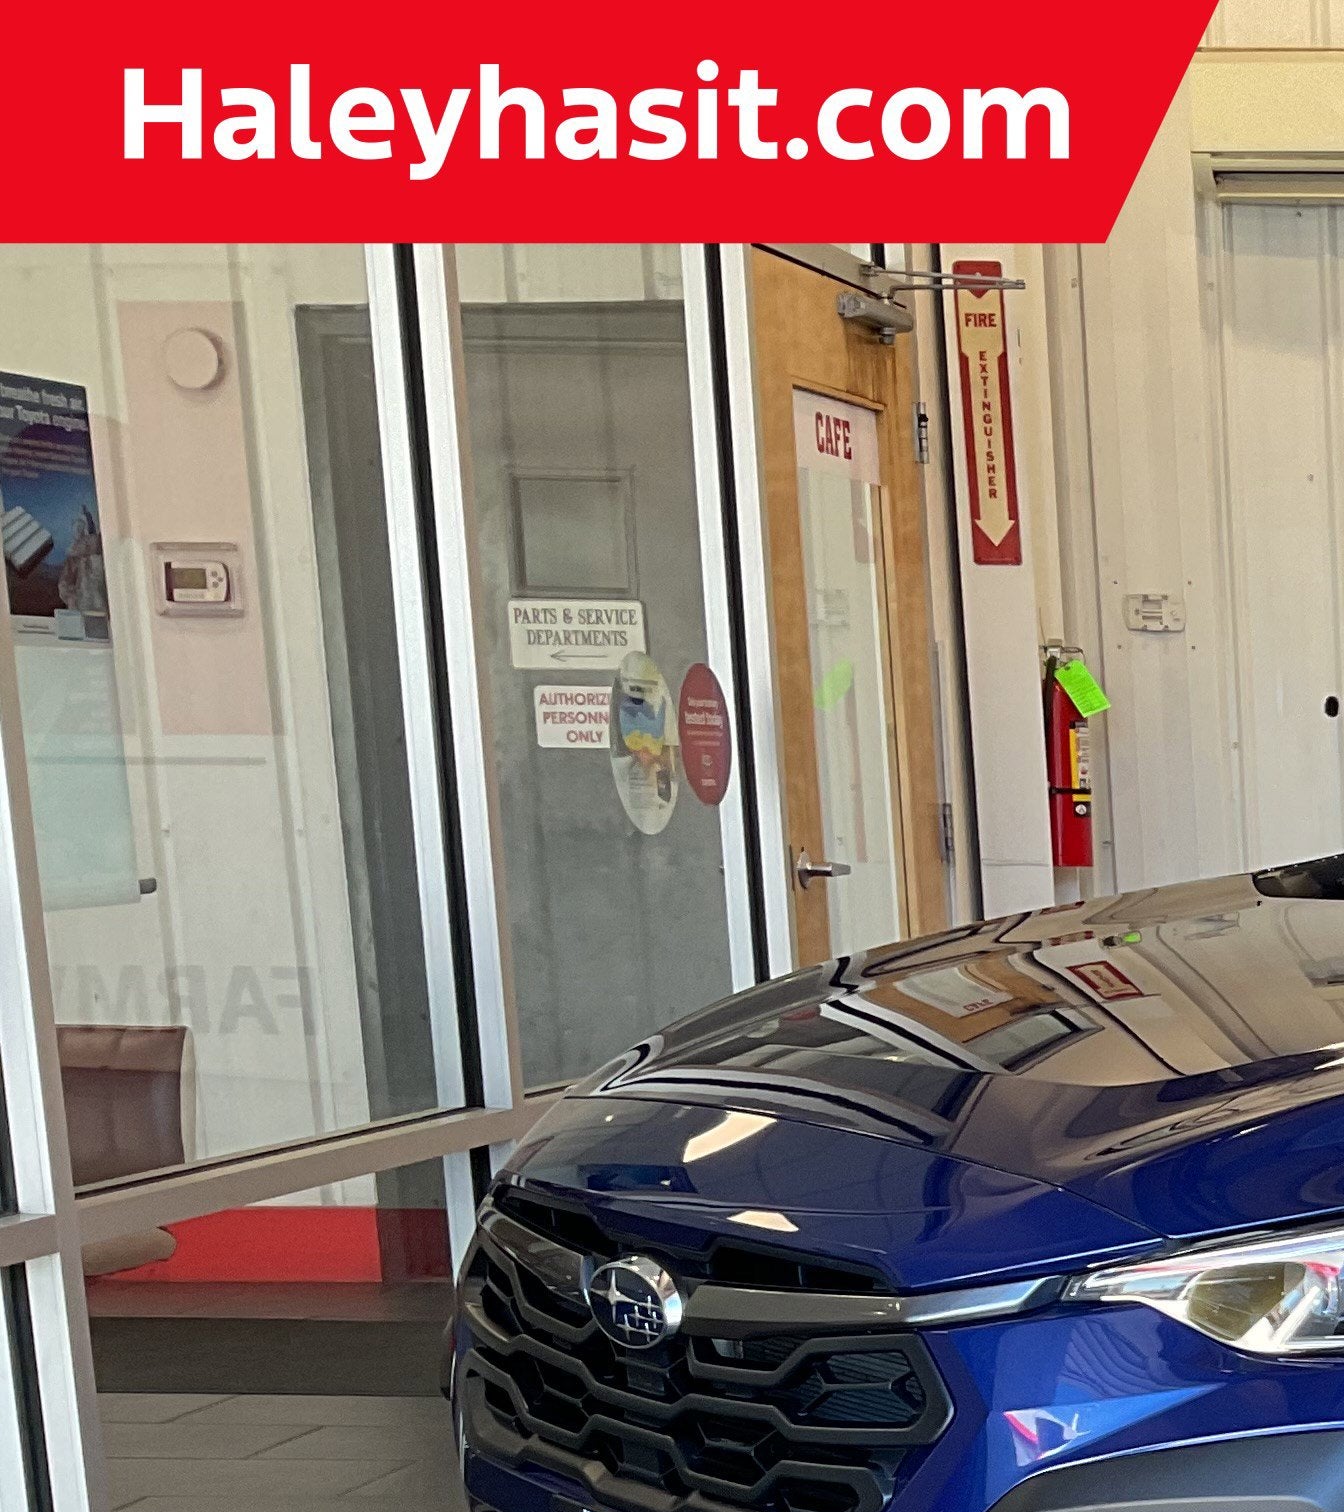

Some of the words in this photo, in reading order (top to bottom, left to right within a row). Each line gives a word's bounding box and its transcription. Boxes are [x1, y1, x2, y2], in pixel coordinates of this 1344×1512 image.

[965, 313, 997, 328] FIRE
[979, 350, 998, 499] EXTINGUISHER
[815, 411, 853, 461] CAFE
[513, 607, 558, 625] PARTS
[562, 608, 573, 625] &
[577, 608, 638, 626] SERVICE
[526, 628, 628, 647] DEPARTMENTS
[566, 729, 604, 744] ONLY
